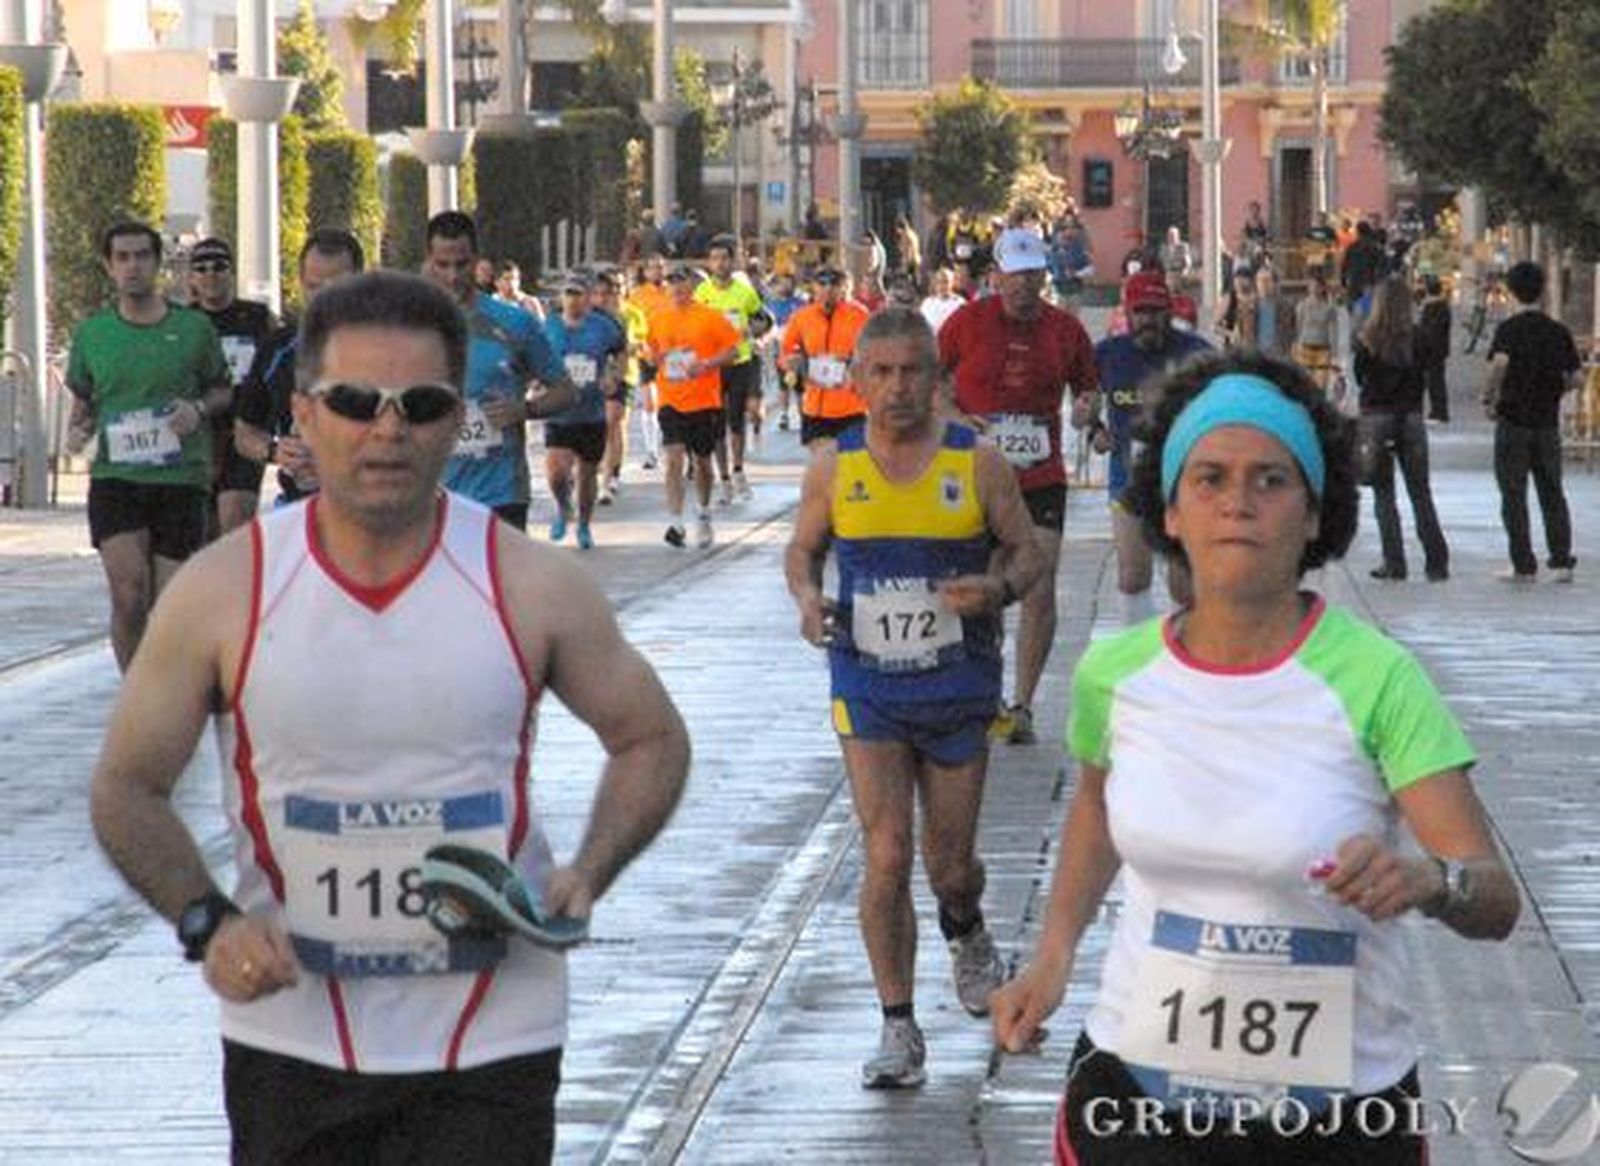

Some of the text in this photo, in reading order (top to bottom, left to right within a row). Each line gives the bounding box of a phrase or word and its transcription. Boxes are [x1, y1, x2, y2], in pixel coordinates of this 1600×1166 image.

[459, 421, 486, 442] 62
[876, 610, 938, 641] 172
[338, 800, 442, 825] LA VOZ
[316, 867, 427, 918] 118
[1200, 922, 1291, 951] LA VOZ
[1161, 988, 1320, 1058] 1187
